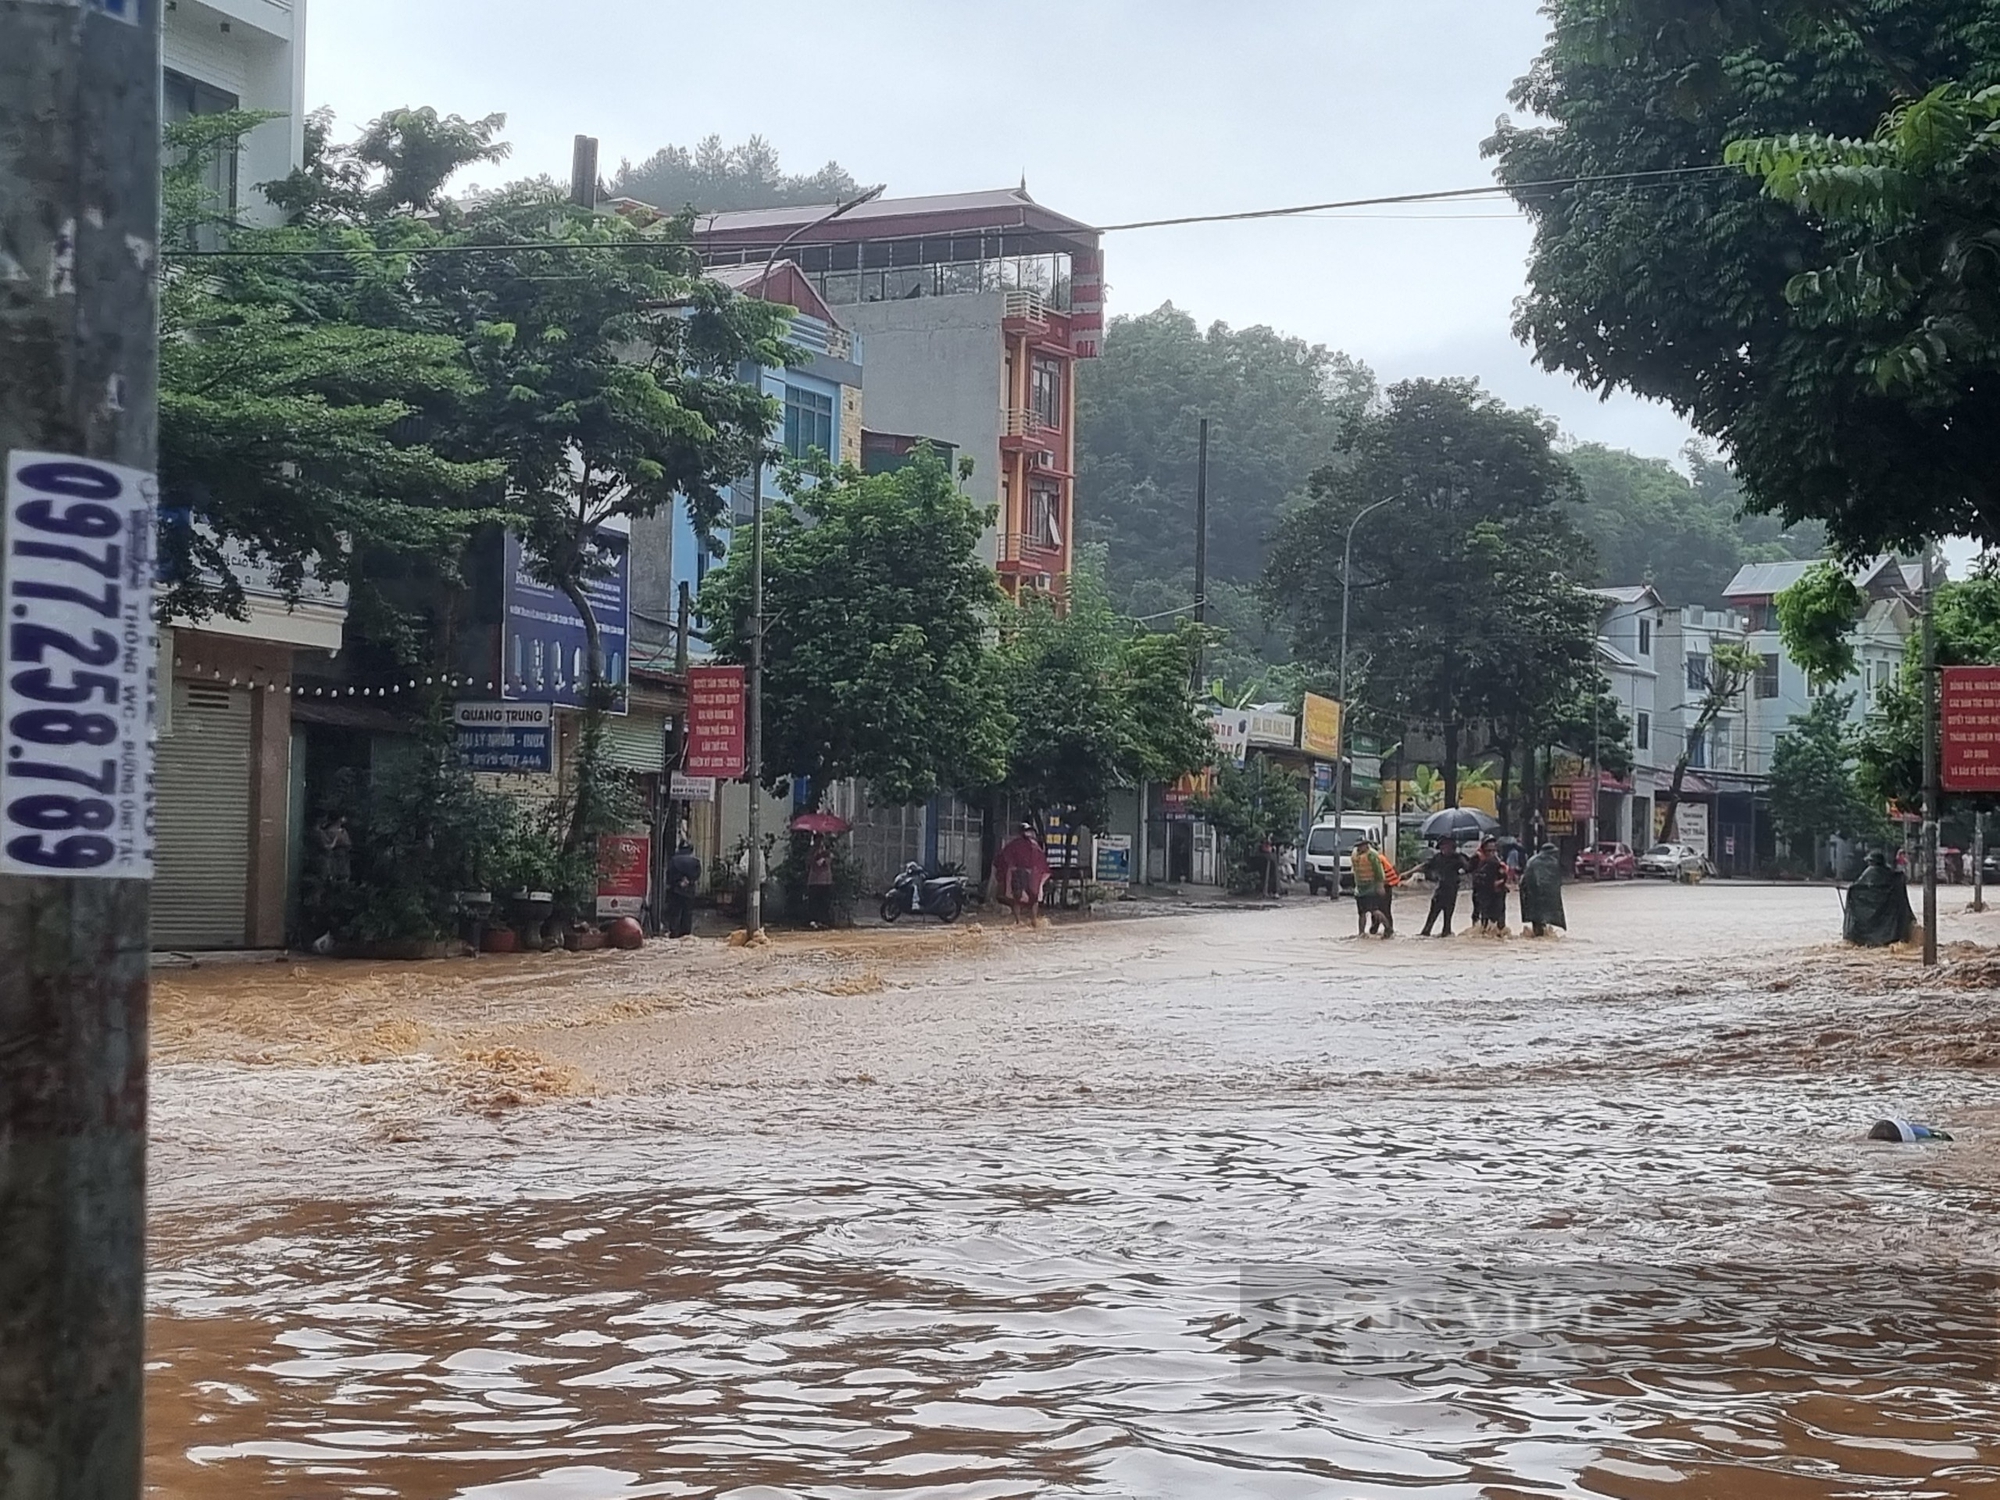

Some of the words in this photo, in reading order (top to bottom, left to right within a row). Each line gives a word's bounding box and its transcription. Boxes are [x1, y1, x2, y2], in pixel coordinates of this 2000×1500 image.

[5, 461, 123, 869] 0977.258.789
[122, 684, 136, 719] WC
[460, 709, 503, 722] QUANG
[505, 710, 544, 722] TRUNG
[523, 733, 545, 748] INOX
